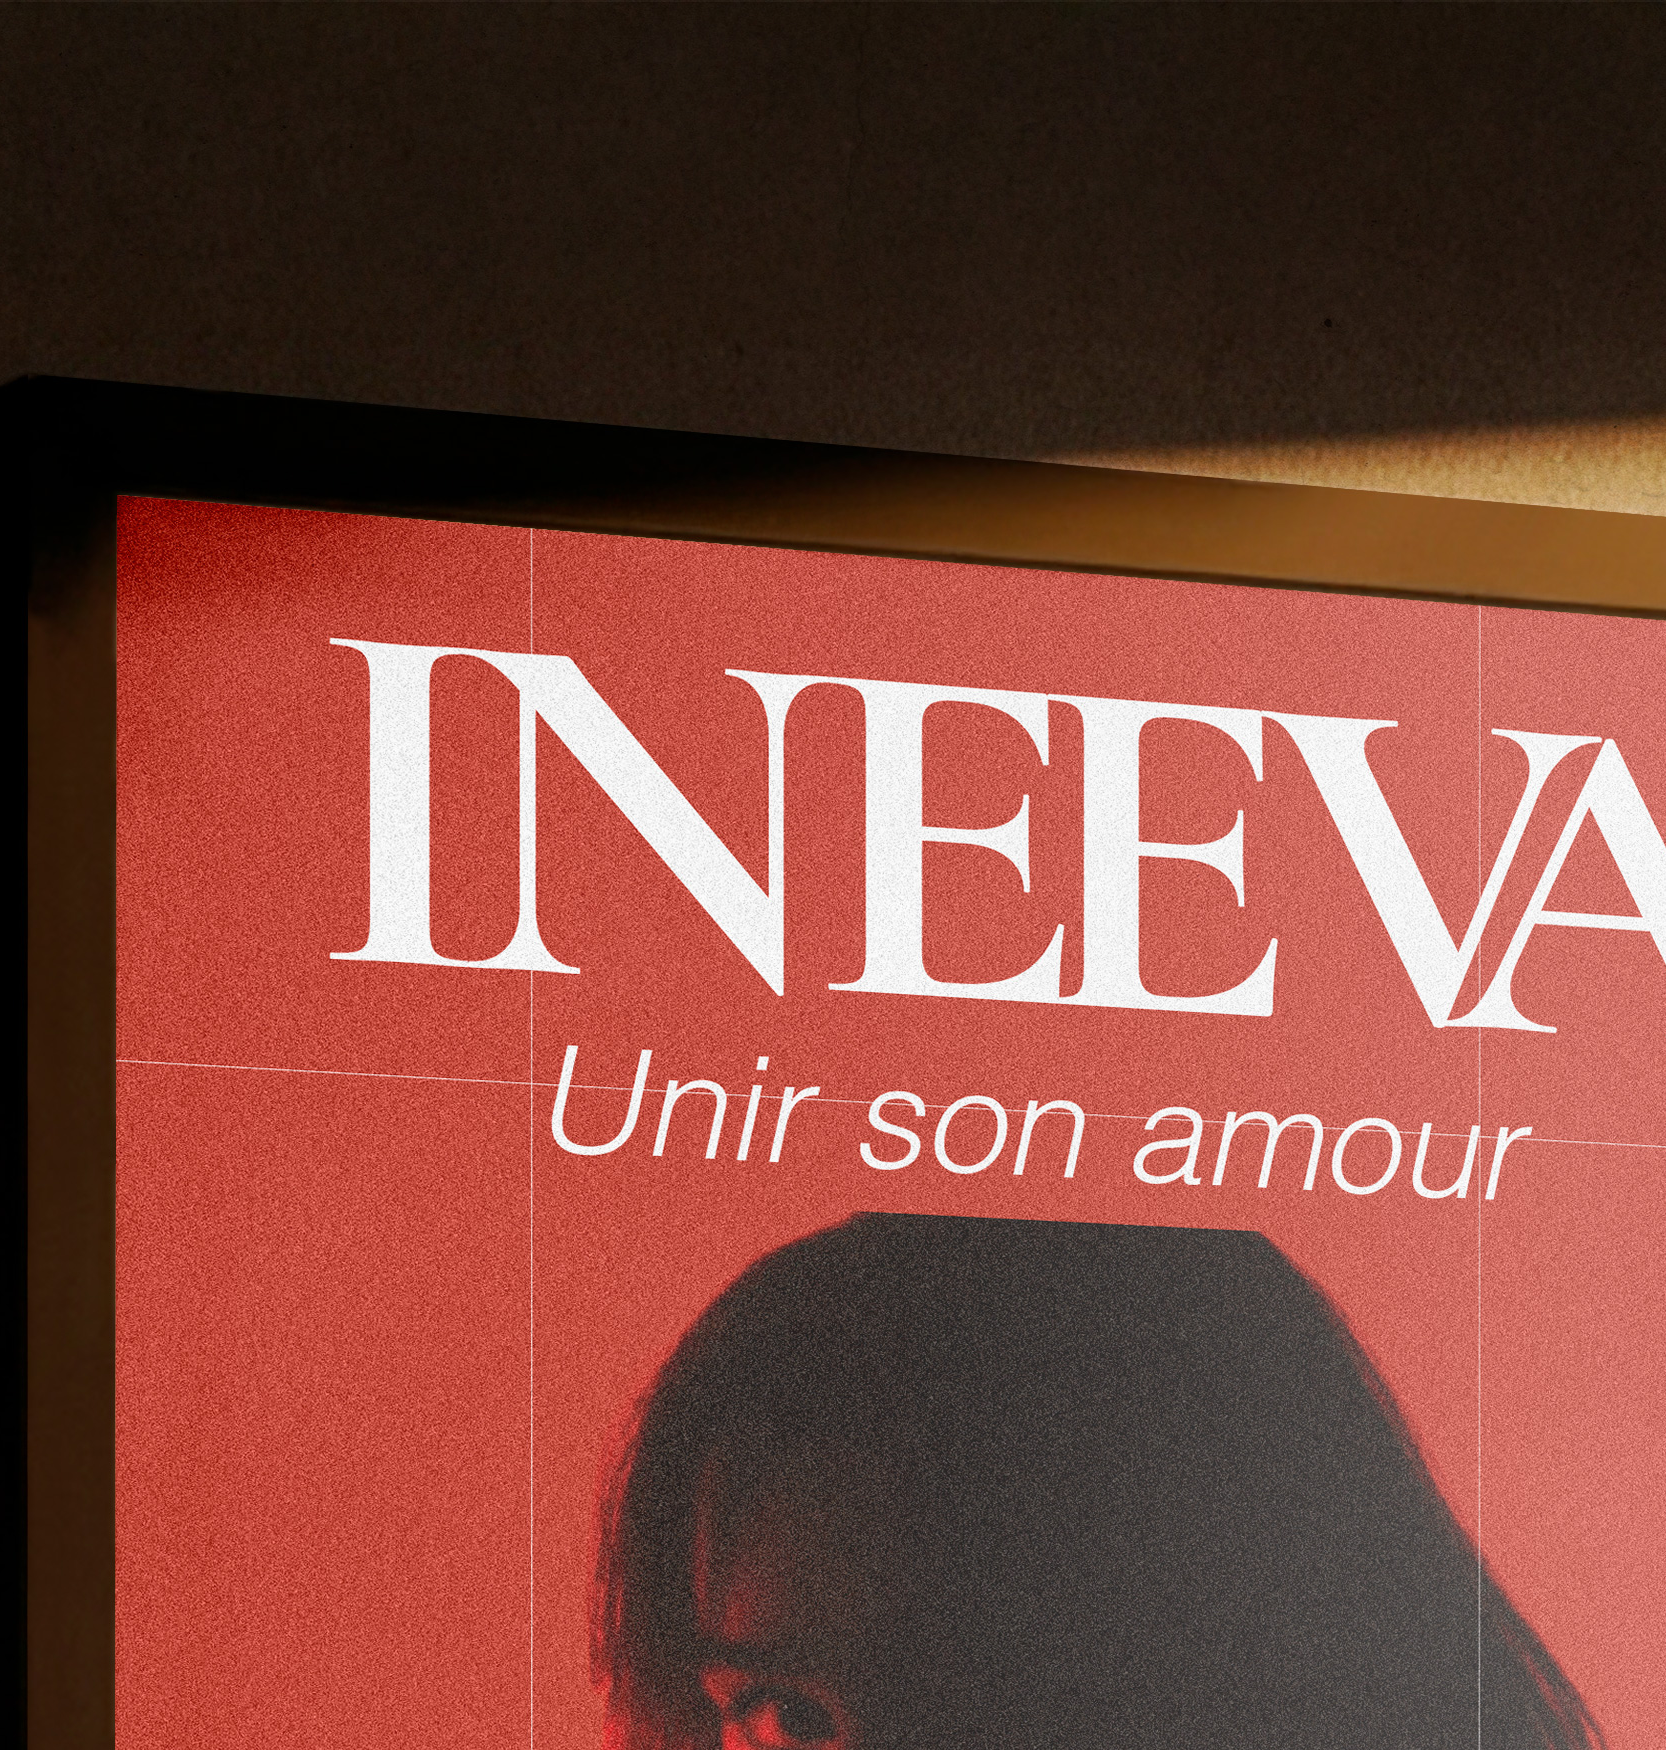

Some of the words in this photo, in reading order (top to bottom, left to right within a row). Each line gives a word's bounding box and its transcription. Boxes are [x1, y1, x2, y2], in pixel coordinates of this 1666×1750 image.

[547, 1044, 818, 1165] Unir
[858, 1089, 1086, 1180] son
[1132, 1102, 1532, 1202] amour
